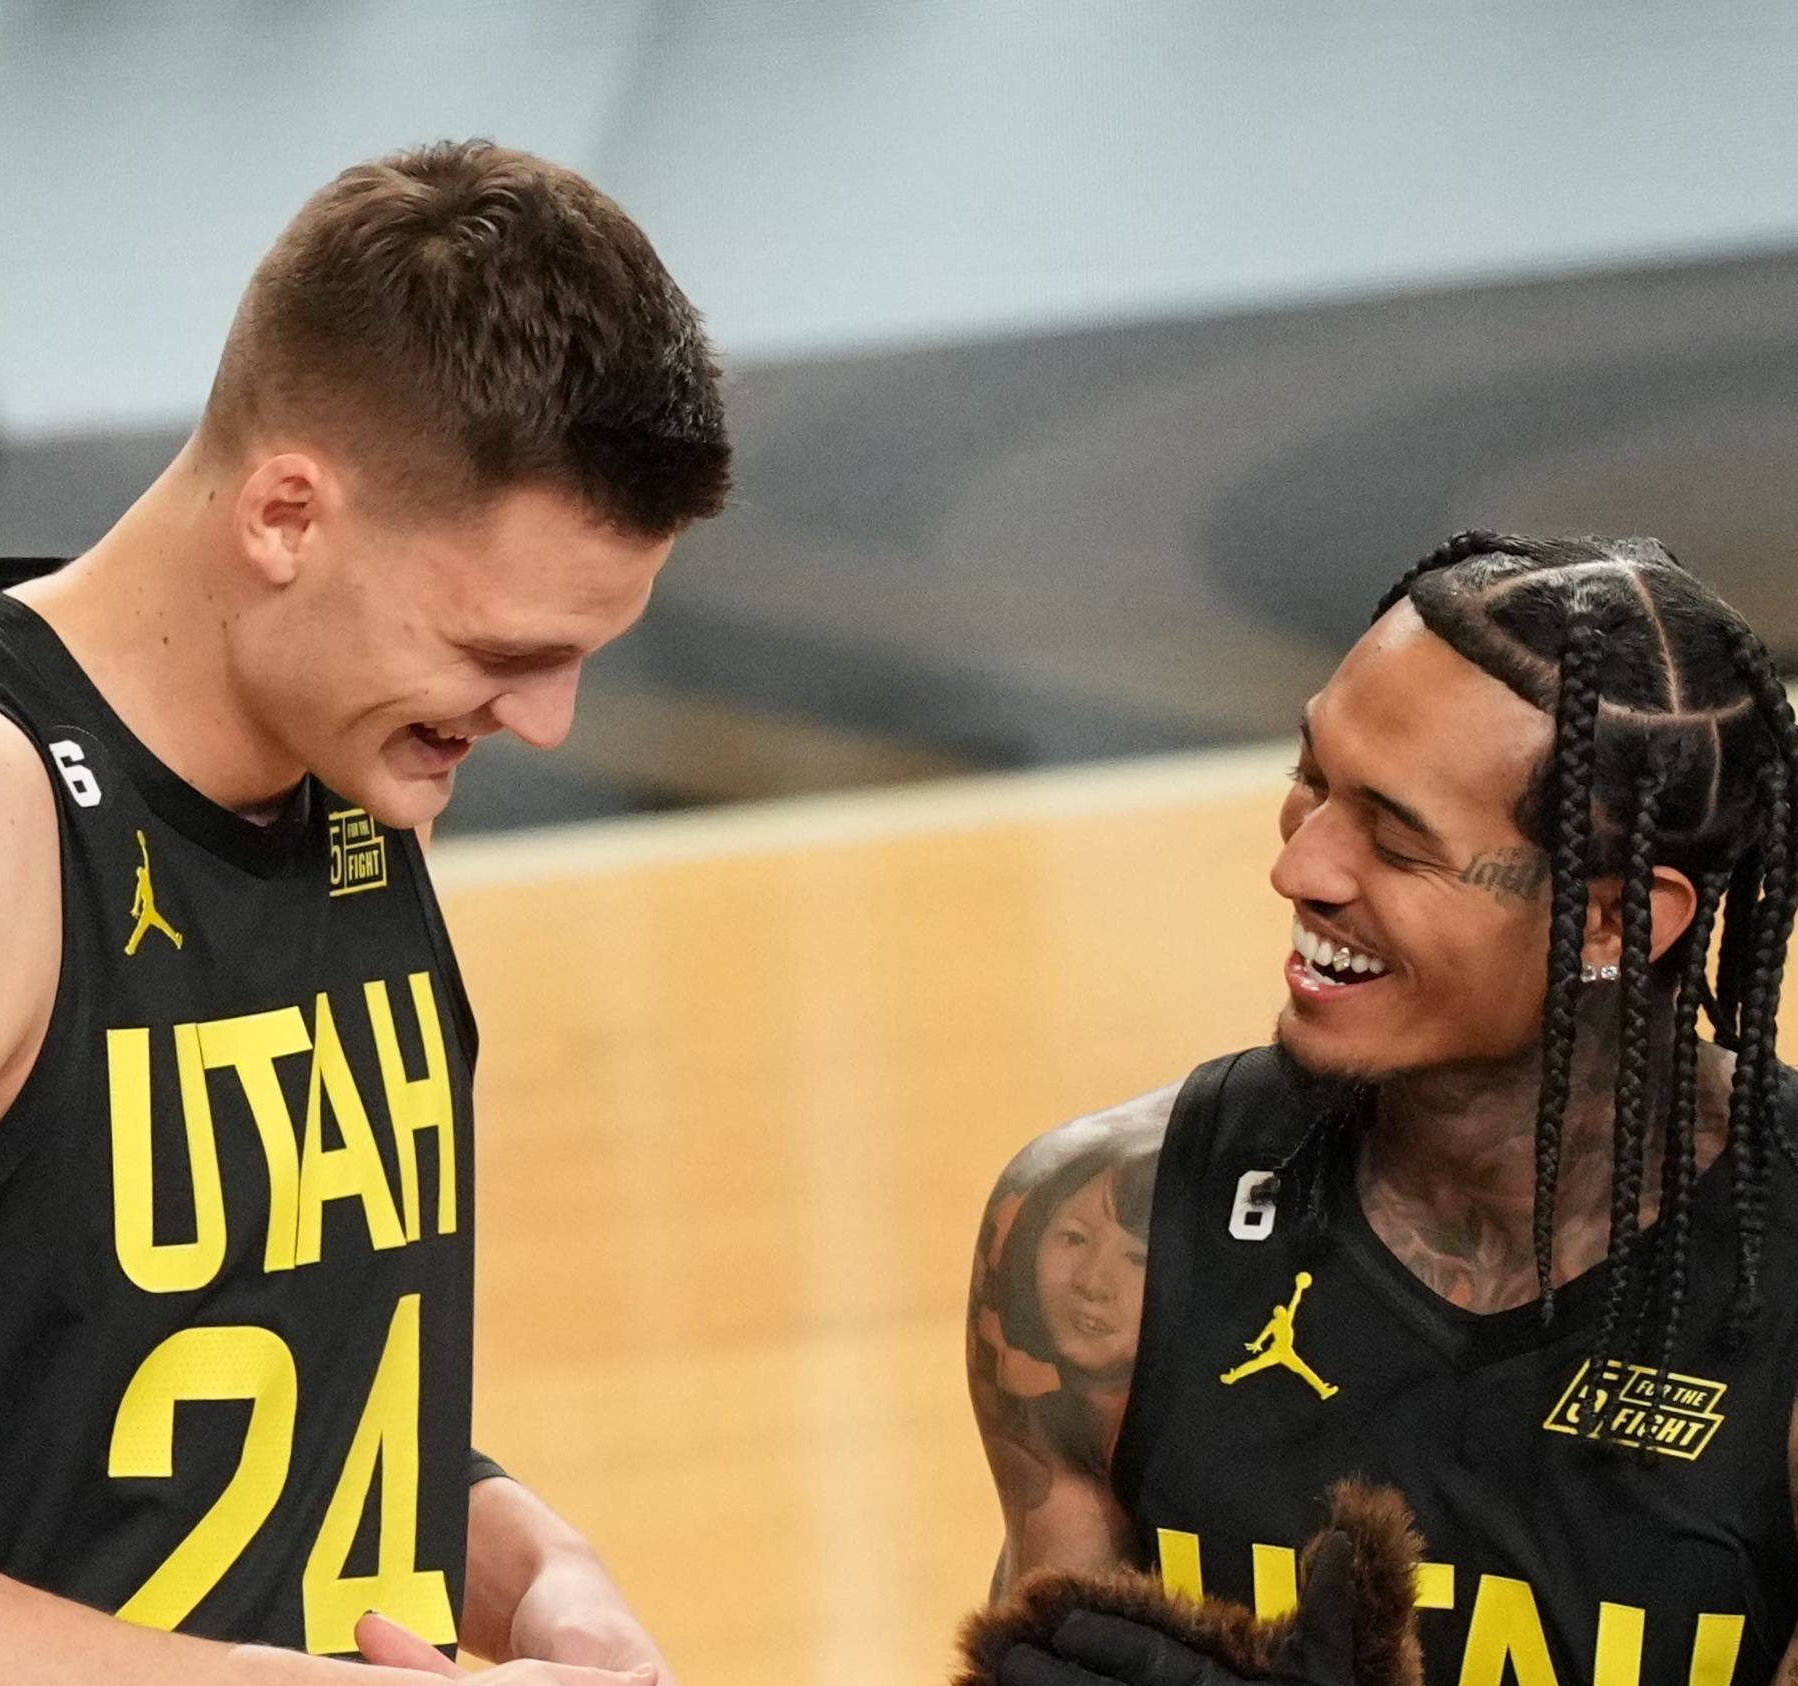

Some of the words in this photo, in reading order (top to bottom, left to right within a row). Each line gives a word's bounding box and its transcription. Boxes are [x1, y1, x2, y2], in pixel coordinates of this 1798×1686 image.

[49, 739, 101, 808] 6
[348, 850, 380, 881] FIGHT
[106, 972, 457, 1293] UTAH
[1228, 1170, 1277, 1241] 6
[1672, 1387, 1708, 1407] THE
[107, 1293, 458, 1655] 24
